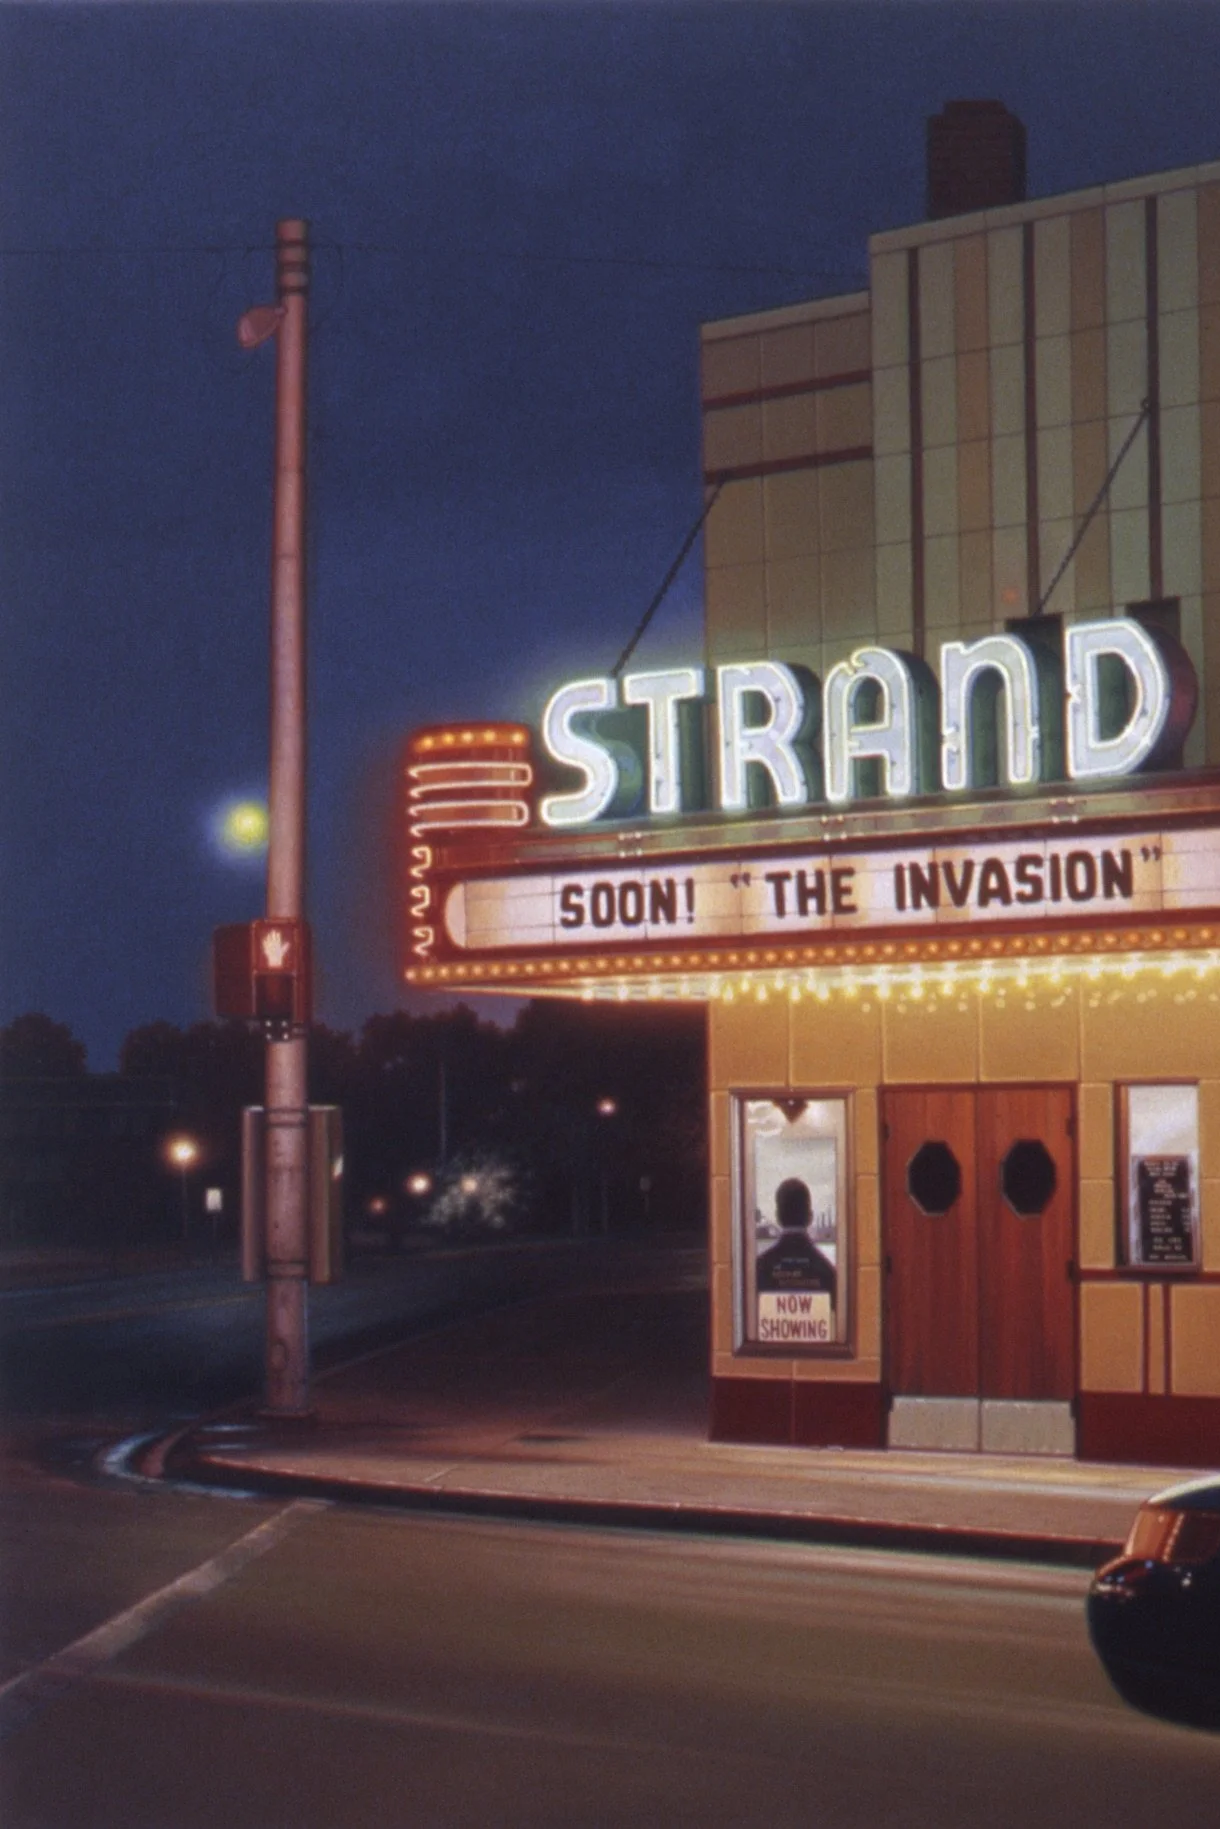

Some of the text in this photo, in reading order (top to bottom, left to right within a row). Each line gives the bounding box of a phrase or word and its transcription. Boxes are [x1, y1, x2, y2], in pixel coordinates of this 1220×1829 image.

[541, 617, 1170, 827] STRAND
[560, 880, 696, 928] SOON!
[776, 1296, 813, 1315] NOW
[761, 1318, 828, 1340] SHOWING
